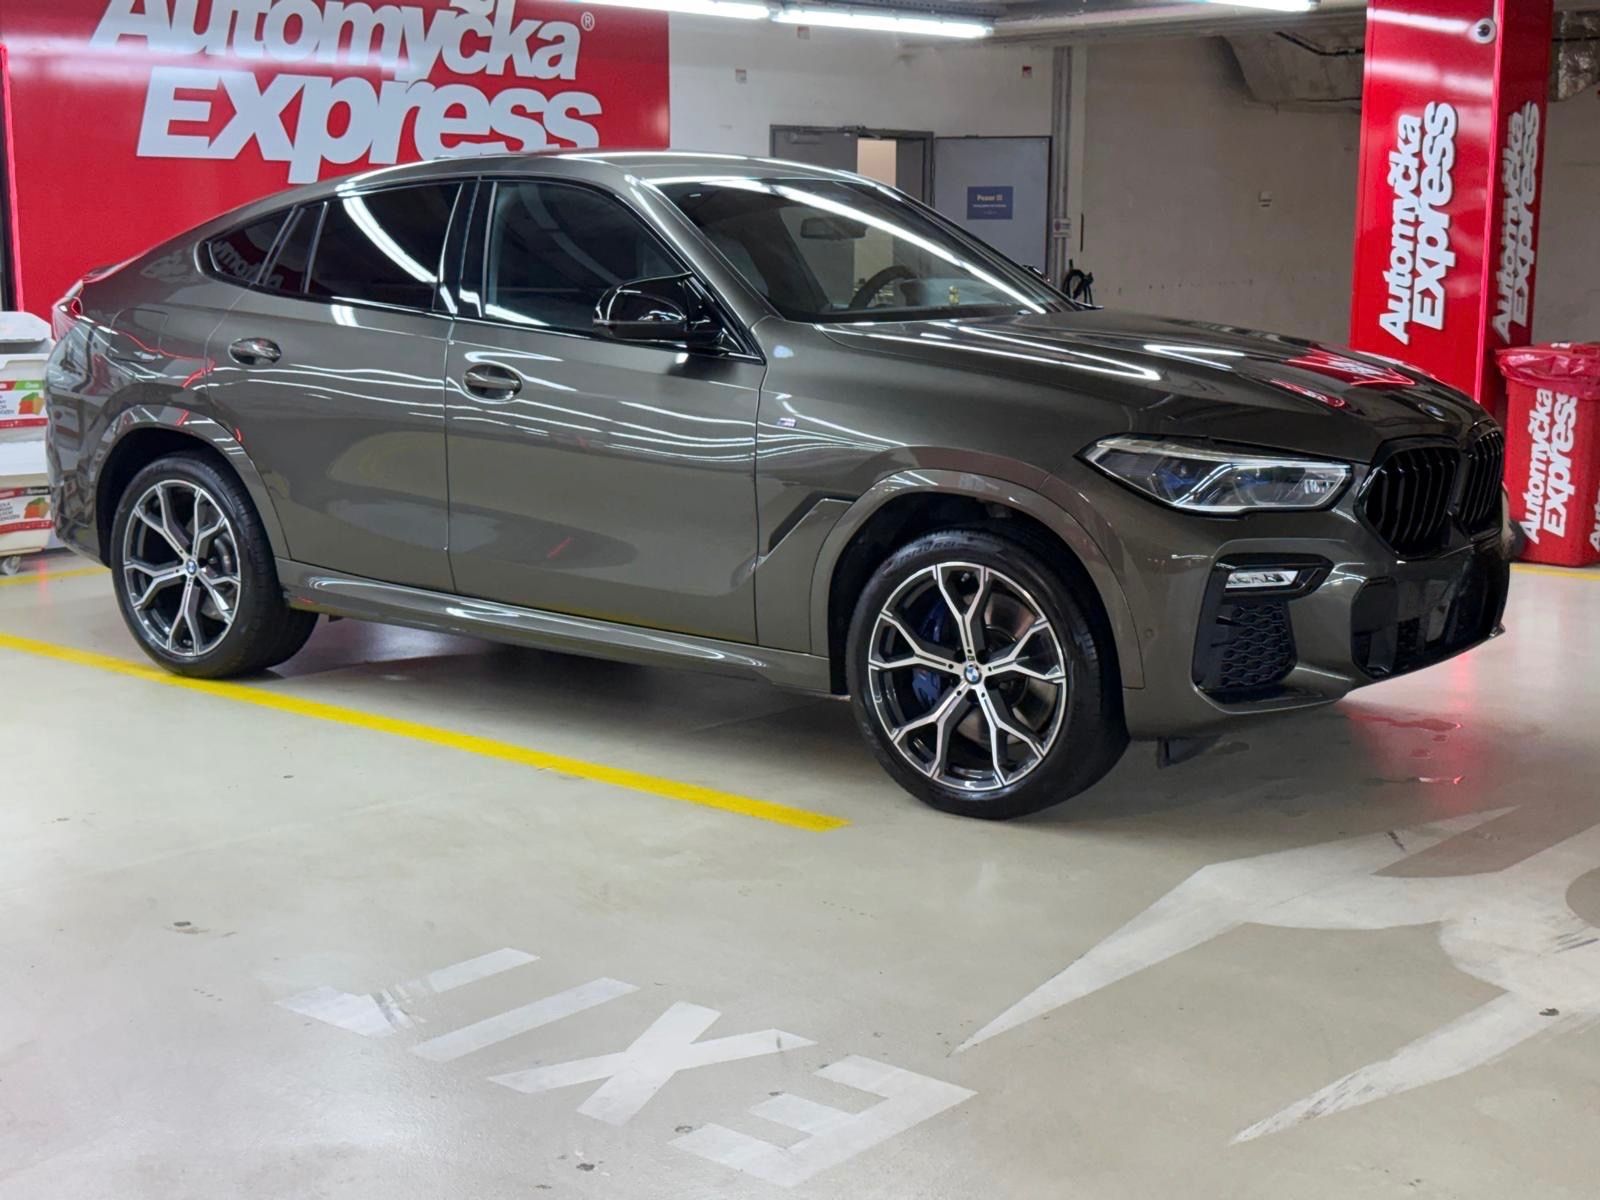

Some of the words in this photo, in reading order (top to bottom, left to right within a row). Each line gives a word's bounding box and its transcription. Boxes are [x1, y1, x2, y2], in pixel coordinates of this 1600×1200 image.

[136, 66, 602, 184] Express
[1379, 114, 1422, 345] Automyčka
[1412, 101, 1457, 330] Express
[1493, 112, 1523, 344] Automyčka
[1512, 101, 1540, 327] Express
[1519, 388, 1553, 544] Automyčka
